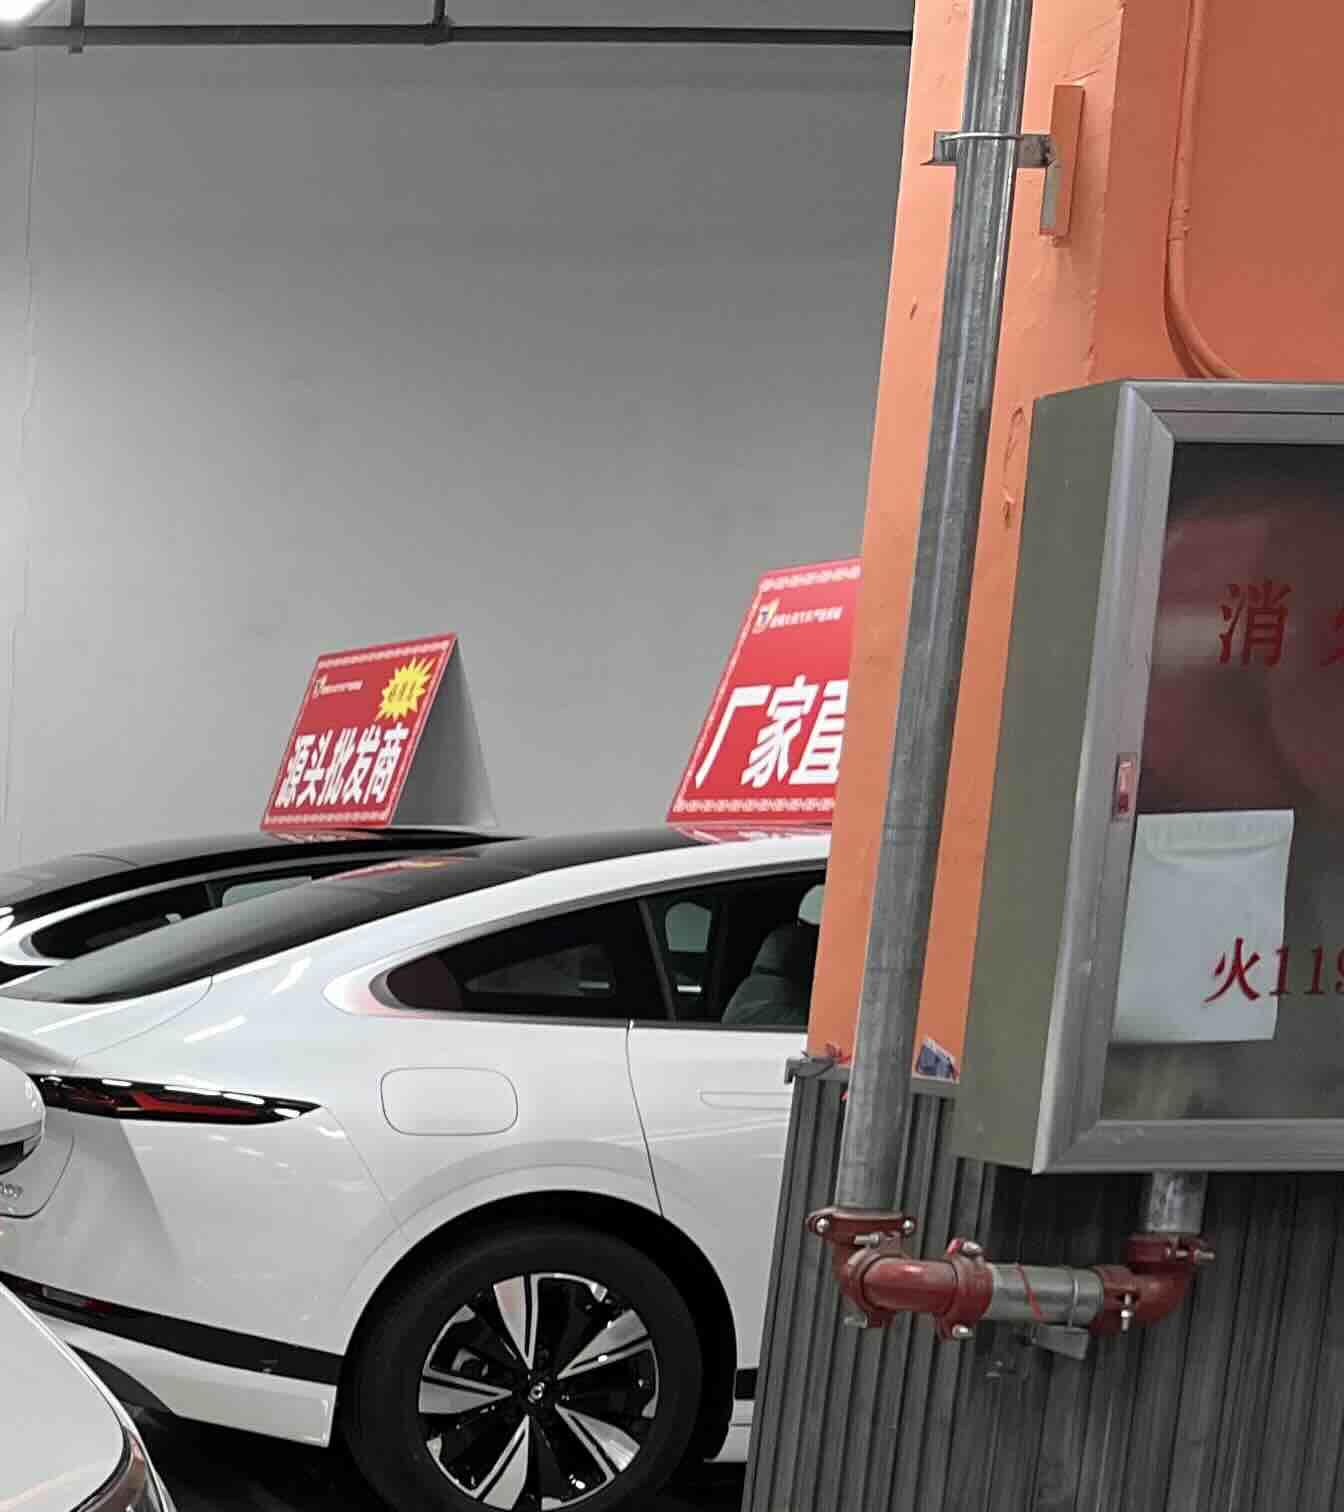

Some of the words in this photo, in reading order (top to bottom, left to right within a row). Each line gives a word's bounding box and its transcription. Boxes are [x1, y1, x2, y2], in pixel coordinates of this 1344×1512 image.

[274, 721, 409, 808] 源头批发商
